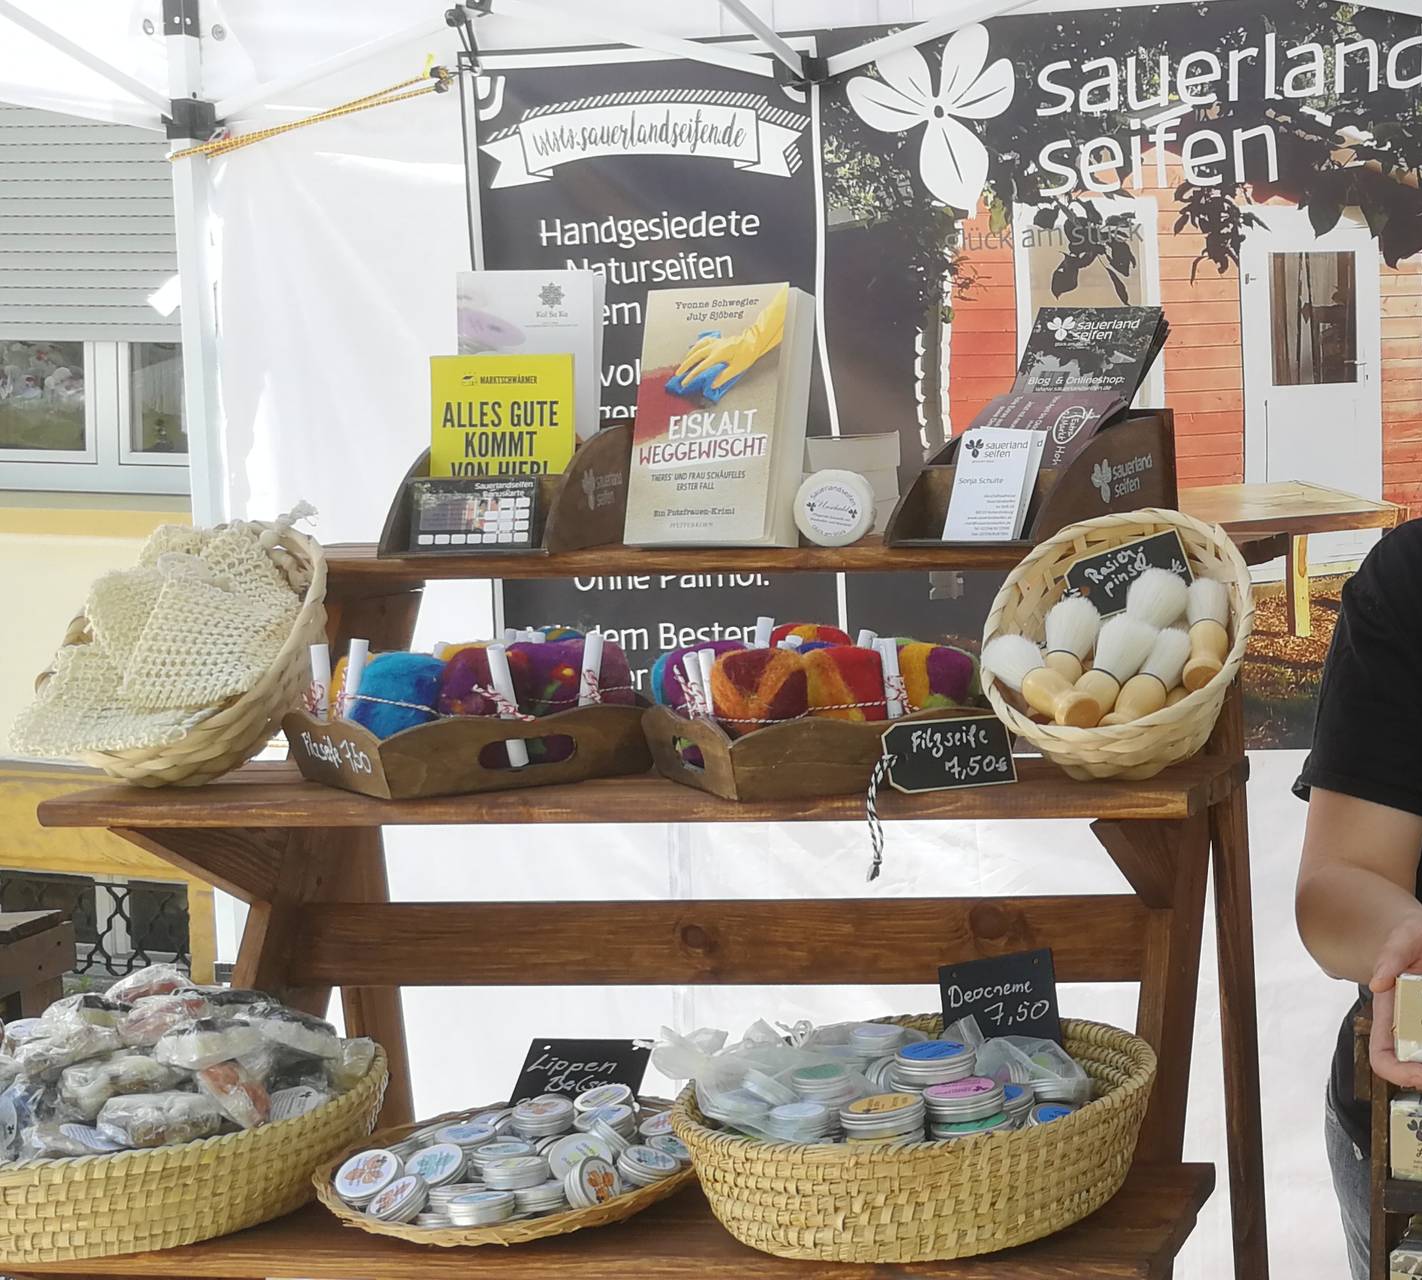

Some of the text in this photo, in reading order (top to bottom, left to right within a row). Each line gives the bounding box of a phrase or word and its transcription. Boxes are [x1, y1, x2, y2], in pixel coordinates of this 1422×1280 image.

[532, 109, 748, 155] www.sauerlandseifen.de
[1038, 107, 1279, 197] seifen
[539, 210, 760, 249] Handgesiedete
[1021, 228, 1063, 248] am
[676, 297, 759, 310] Yvonne Schwegler
[687, 310, 744, 321] July Sjöberg
[1076, 318, 1140, 331] sauerland
[1073, 330, 1112, 340] seifen
[480, 374, 538, 385] MARKTSCHWÄRMER
[1027, 375, 1125, 387] Blog & Onlineshop:
[442, 400, 559, 428] ALLES GUTE
[668, 409, 757, 440] EISKALT
[464, 431, 538, 458] KOMMT
[639, 436, 766, 466] WEGGEWISCHT
[983, 450, 1011, 459] seifen
[985, 441, 1029, 450] sauerland
[450, 461, 492, 476] VON
[674, 471, 687, 481] UND
[688, 471, 706, 480] FRAU
[1112, 453, 1153, 479] sauerland
[676, 482, 715, 491] ERSTER FALL
[1114, 477, 1140, 498] seifen
[911, 724, 989, 758] Filzseife
[948, 980, 1033, 1008] Deocreme
[985, 999, 1050, 1028] 7,50
[527, 1053, 618, 1080] Lippen
